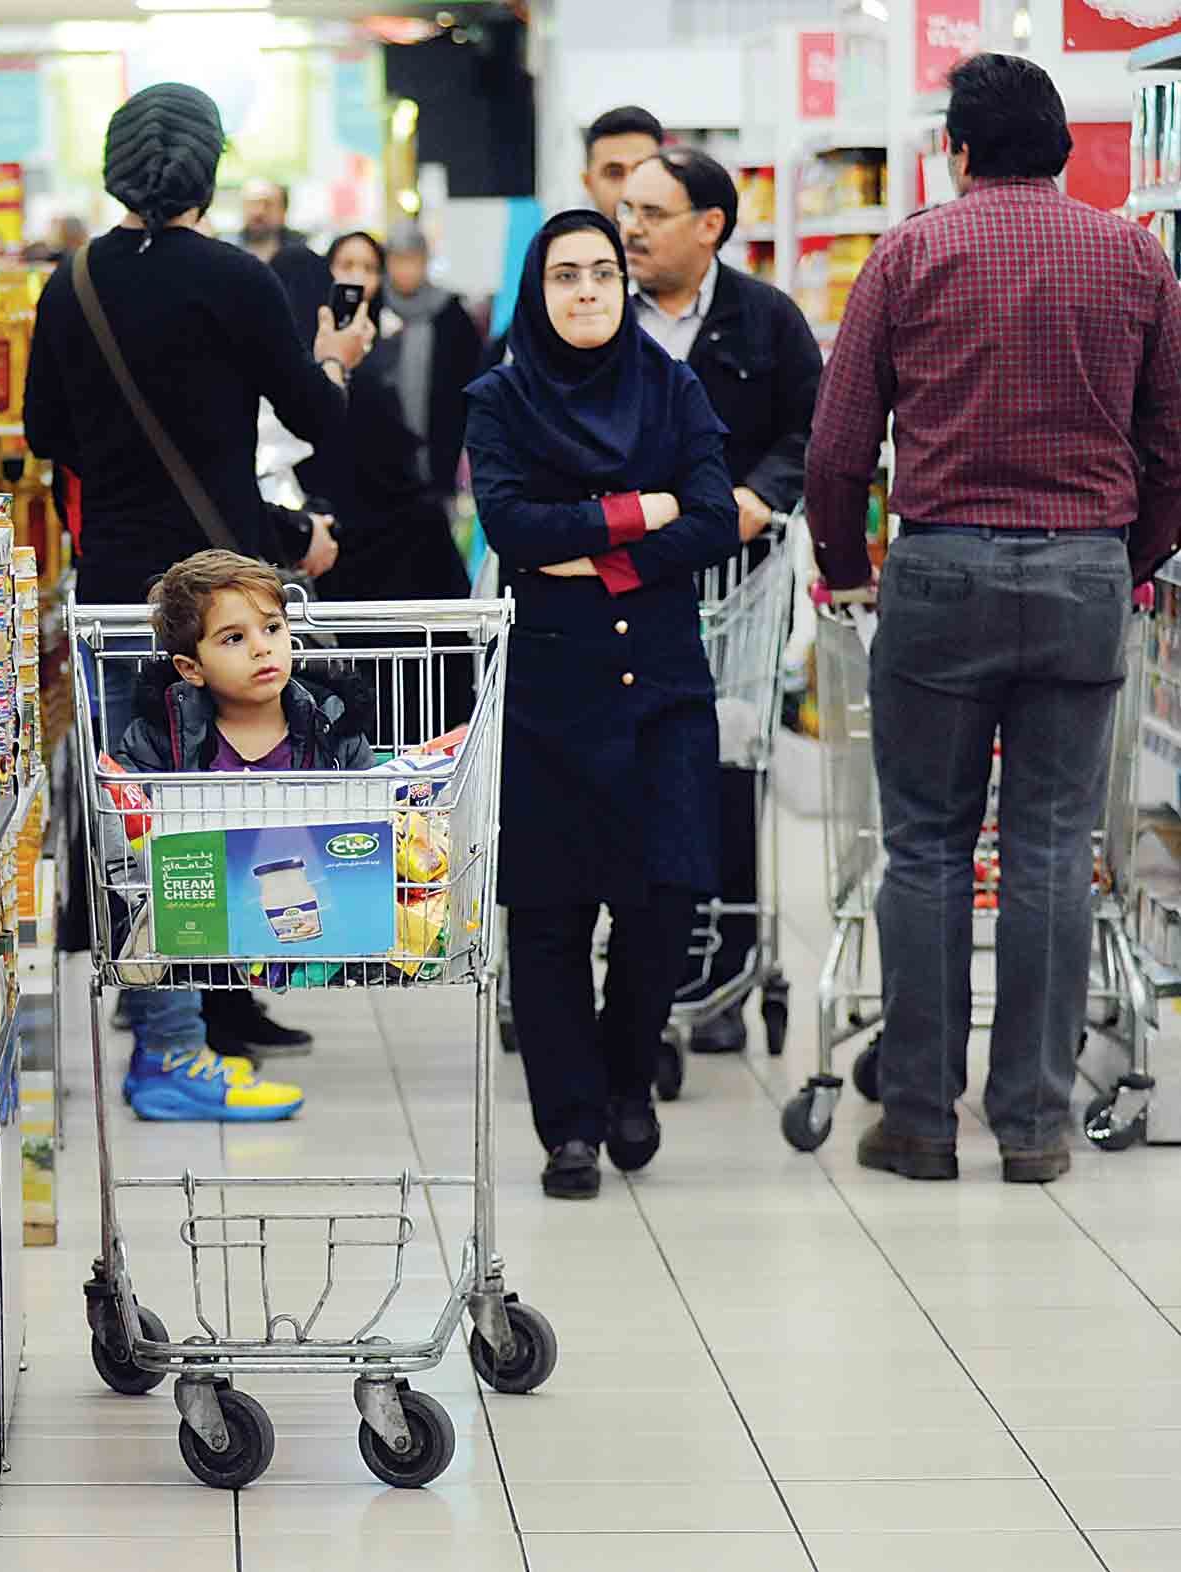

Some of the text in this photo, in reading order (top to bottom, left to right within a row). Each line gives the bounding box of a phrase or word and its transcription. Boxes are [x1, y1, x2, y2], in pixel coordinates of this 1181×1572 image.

[331, 839, 374, 853] صباح
[163, 880, 215, 890] CREAM
[164, 890, 216, 900] CHEESE
